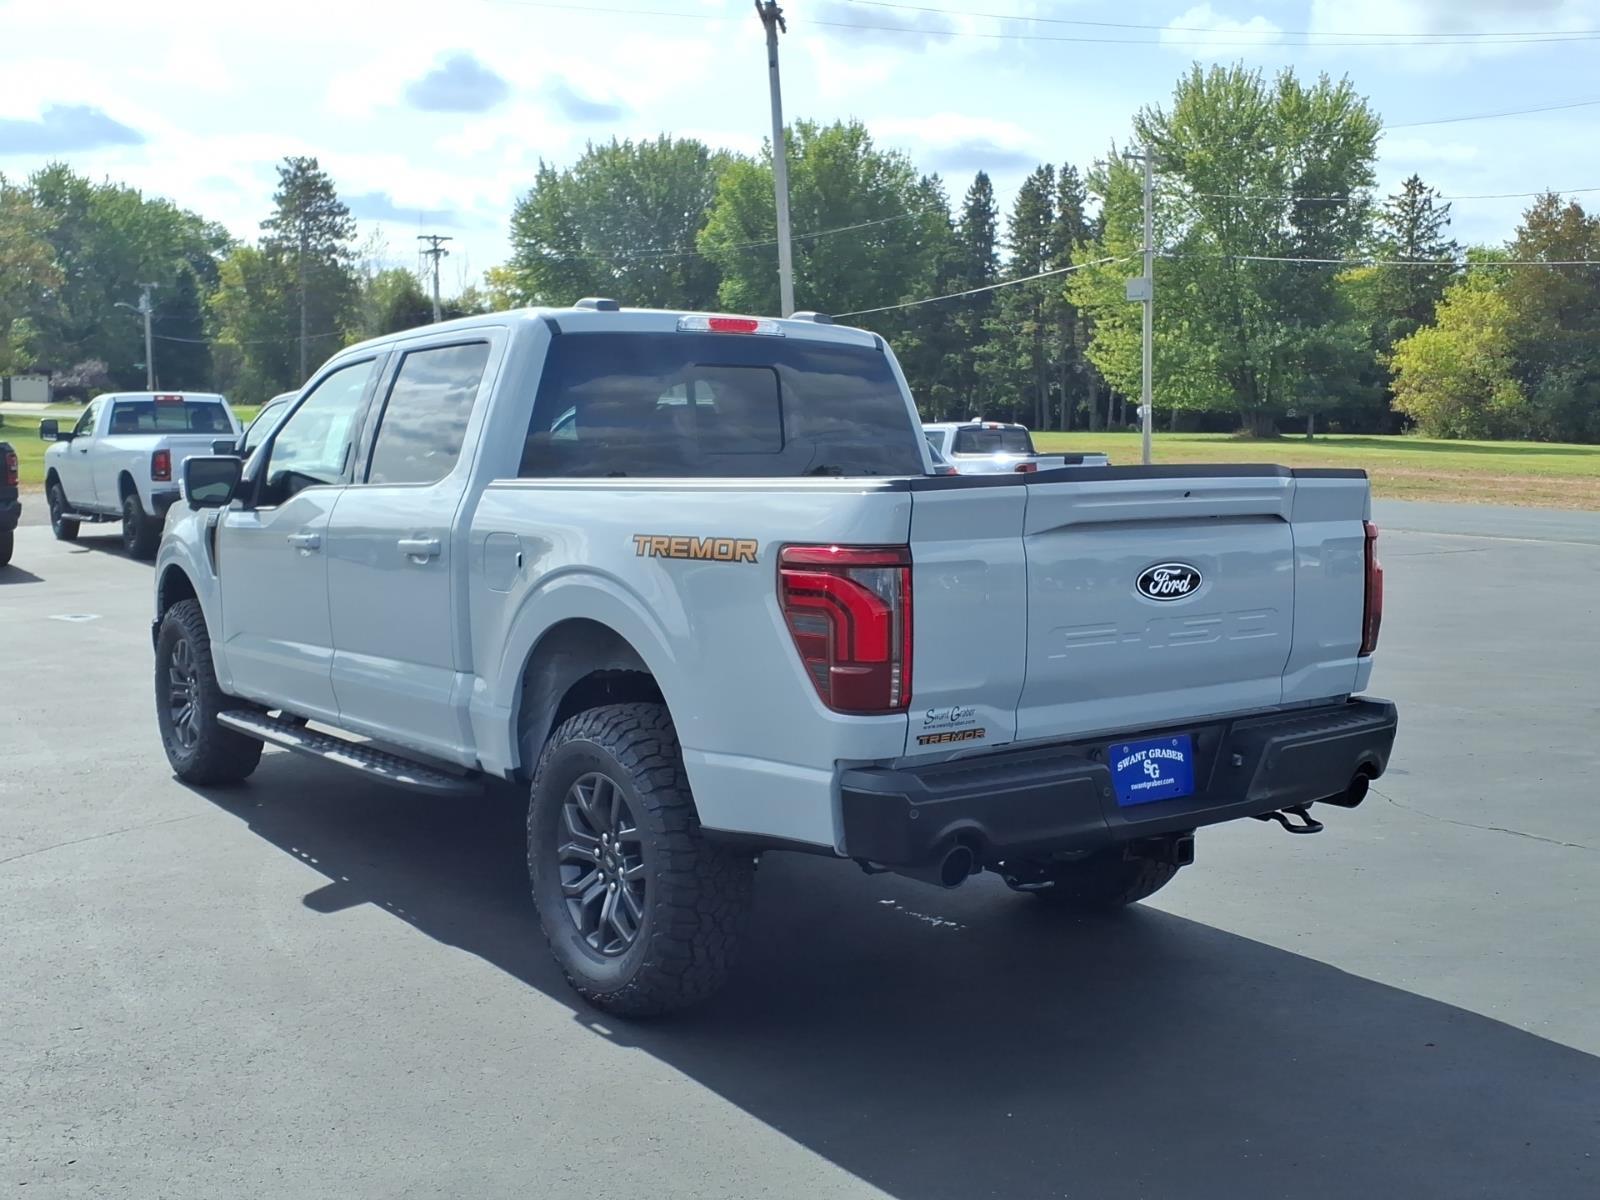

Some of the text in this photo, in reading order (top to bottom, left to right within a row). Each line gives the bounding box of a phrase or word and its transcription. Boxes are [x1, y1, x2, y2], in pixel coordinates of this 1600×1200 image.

[633, 534, 759, 564] TREMOR
[1149, 568, 1192, 595] Ford
[924, 706, 976, 725] Swant Graber
[916, 727, 986, 745] TREMOR
[1117, 748, 1184, 772] SWANT GRABER
[1143, 759, 1160, 778] SG
[1130, 777, 1175, 790] swantgraber.com
